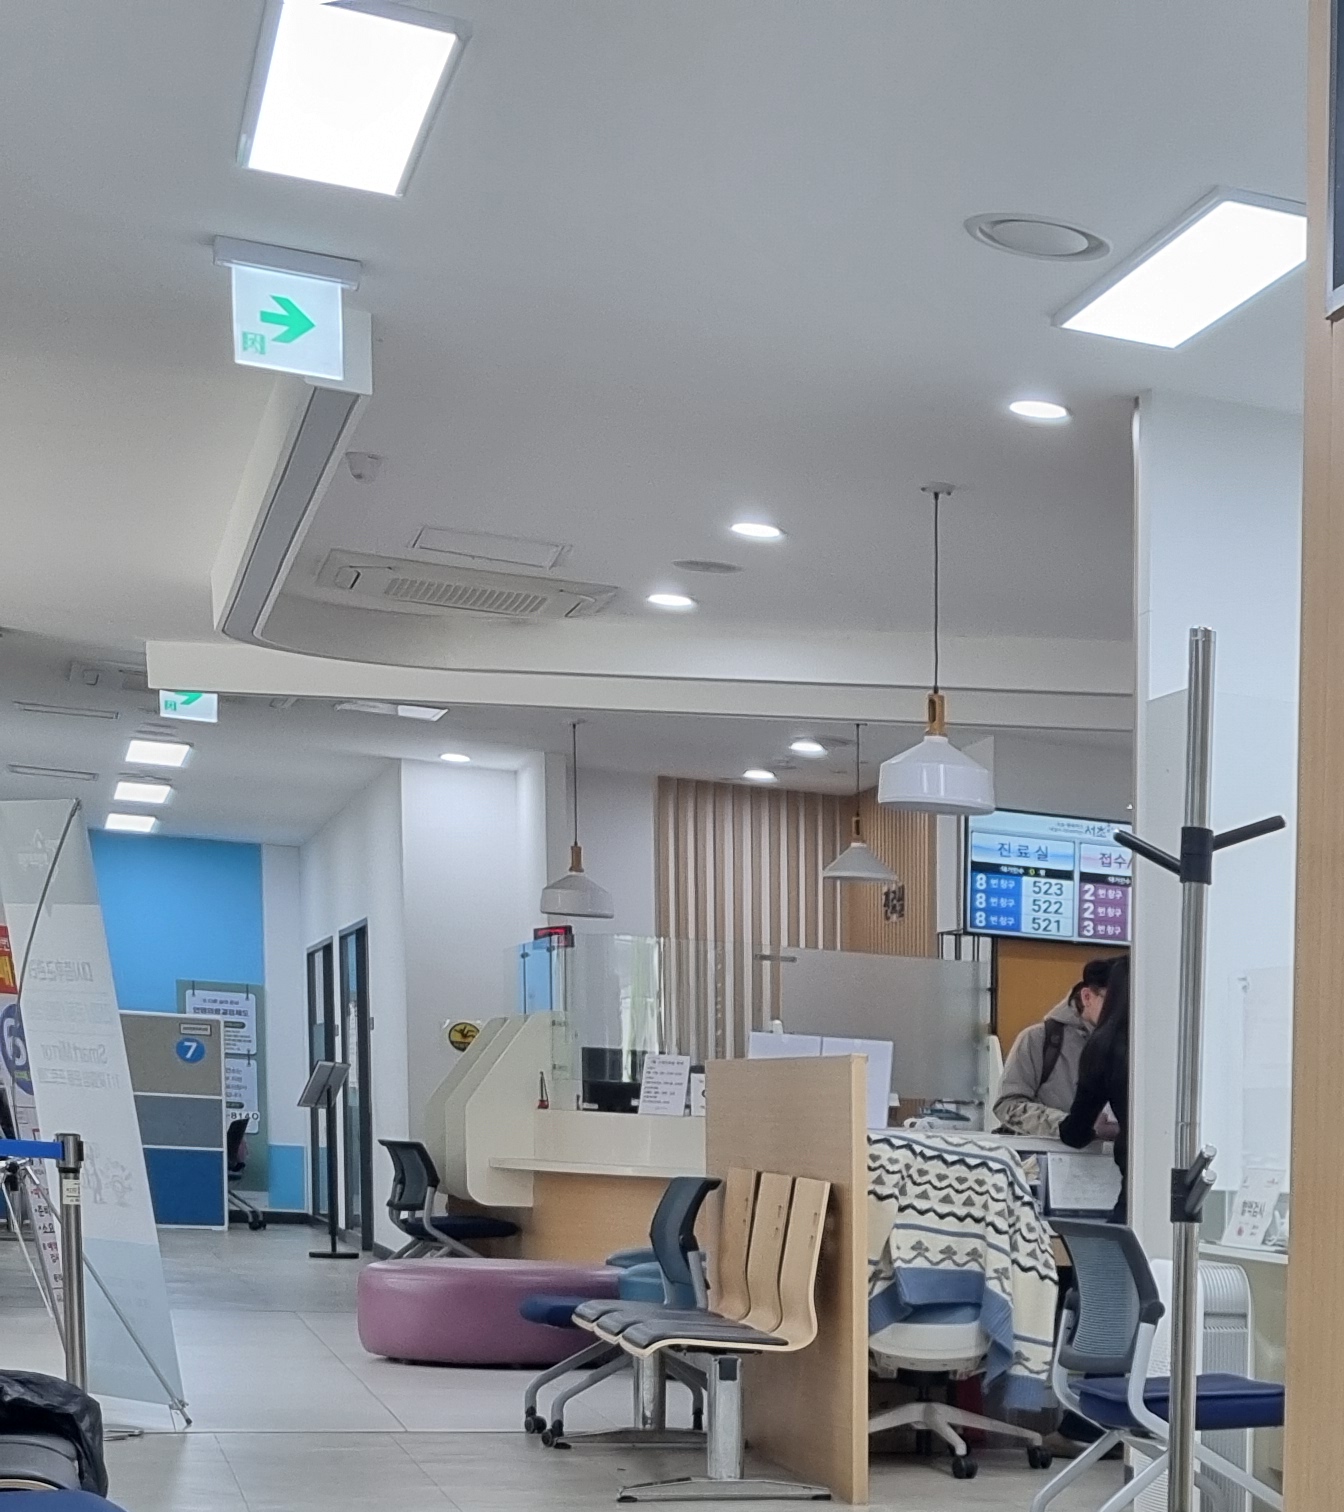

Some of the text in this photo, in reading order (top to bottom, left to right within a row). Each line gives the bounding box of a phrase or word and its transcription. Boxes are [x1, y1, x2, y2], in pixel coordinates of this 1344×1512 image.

[997, 841, 1049, 862] 진료실
[976, 873, 987, 890] 8
[1032, 881, 1064, 897] 523
[976, 892, 987, 908] 8
[1083, 884, 1095, 900] 2
[1031, 899, 1063, 915] 522
[1083, 902, 1095, 919] 2
[976, 911, 987, 927] 8
[1031, 917, 1061, 933] 521
[1083, 920, 1094, 936] 3
[183, 1041, 197, 1059] 7
